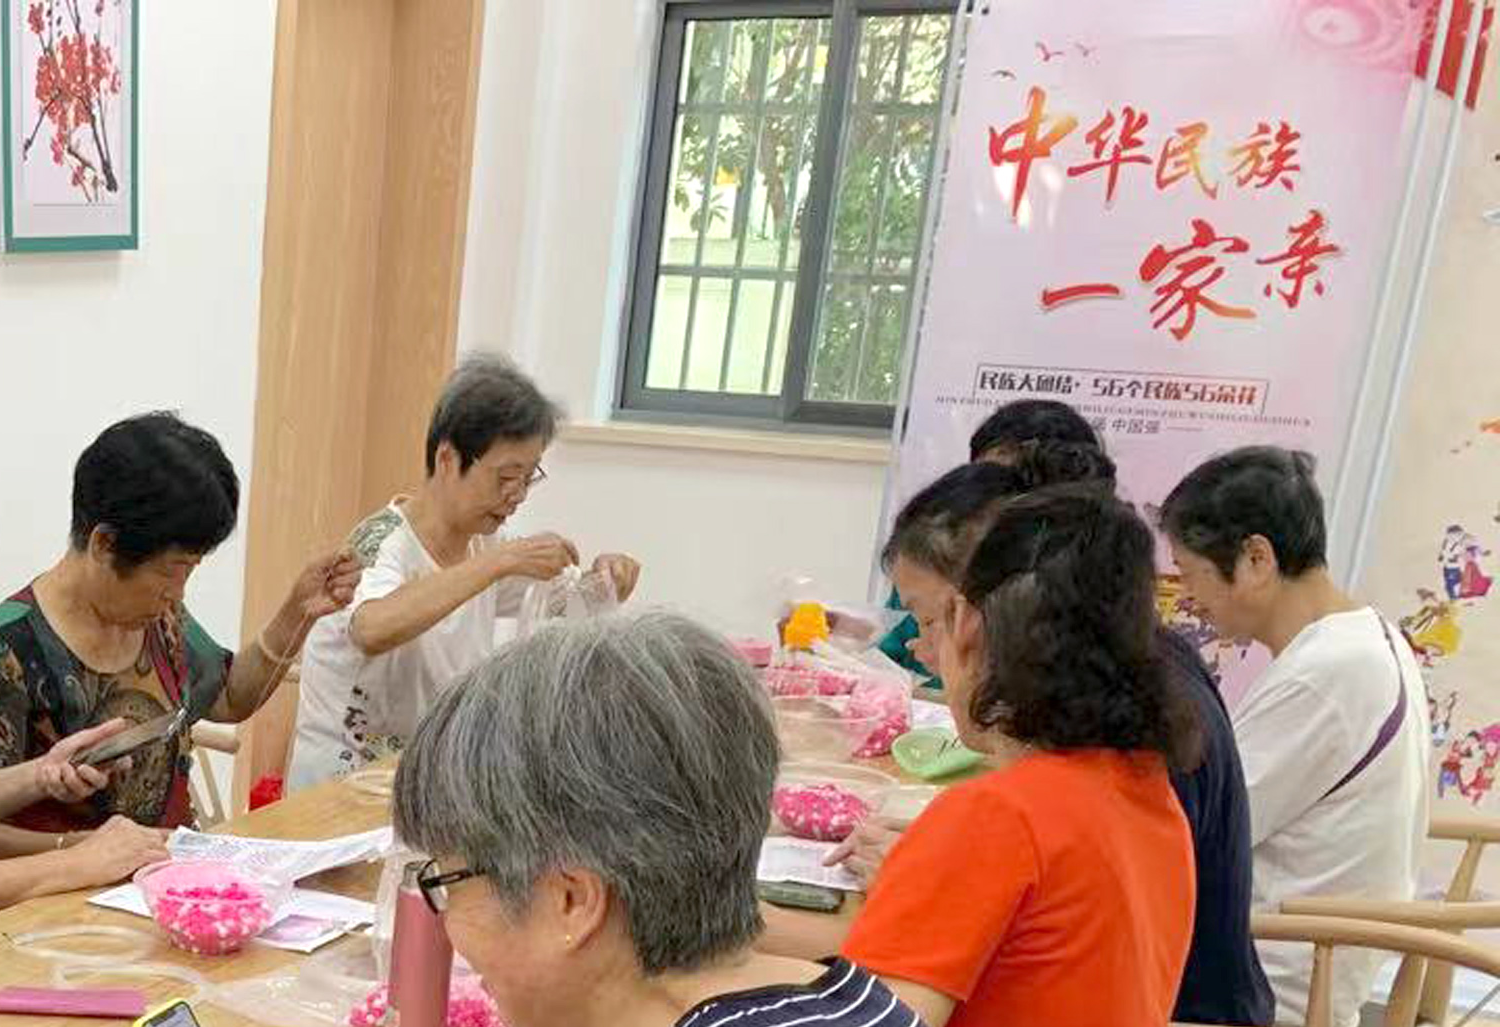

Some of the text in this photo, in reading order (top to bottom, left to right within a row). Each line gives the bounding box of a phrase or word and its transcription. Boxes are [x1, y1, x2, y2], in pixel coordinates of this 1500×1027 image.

[988, 86, 1302, 219] 中华民族
[1041, 210, 1339, 341] 一家亲
